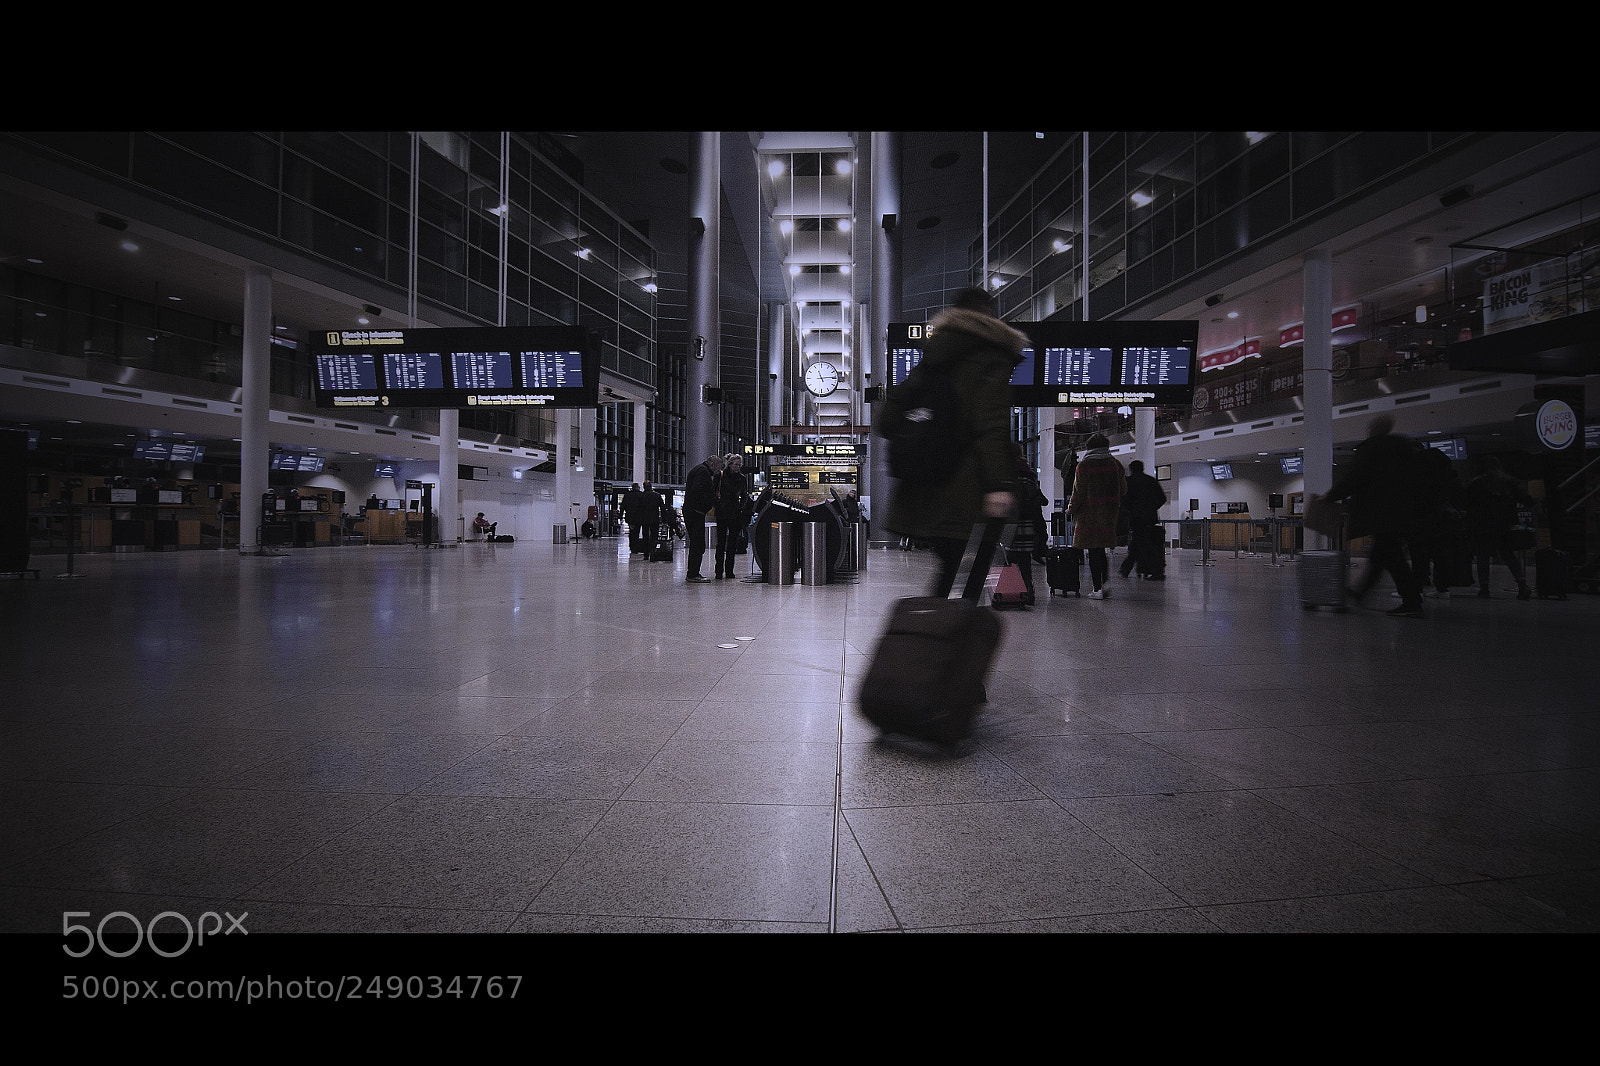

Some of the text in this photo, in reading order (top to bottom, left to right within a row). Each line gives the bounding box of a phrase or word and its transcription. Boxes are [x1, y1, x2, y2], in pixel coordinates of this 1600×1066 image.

[1489, 271, 1531, 296] BACON
[1490, 287, 1529, 312] KING
[381, 395, 389, 406] 3
[1213, 386, 1234, 400] 200+
[1543, 411, 1572, 425] BURGER
[1543, 419, 1573, 436] KING
